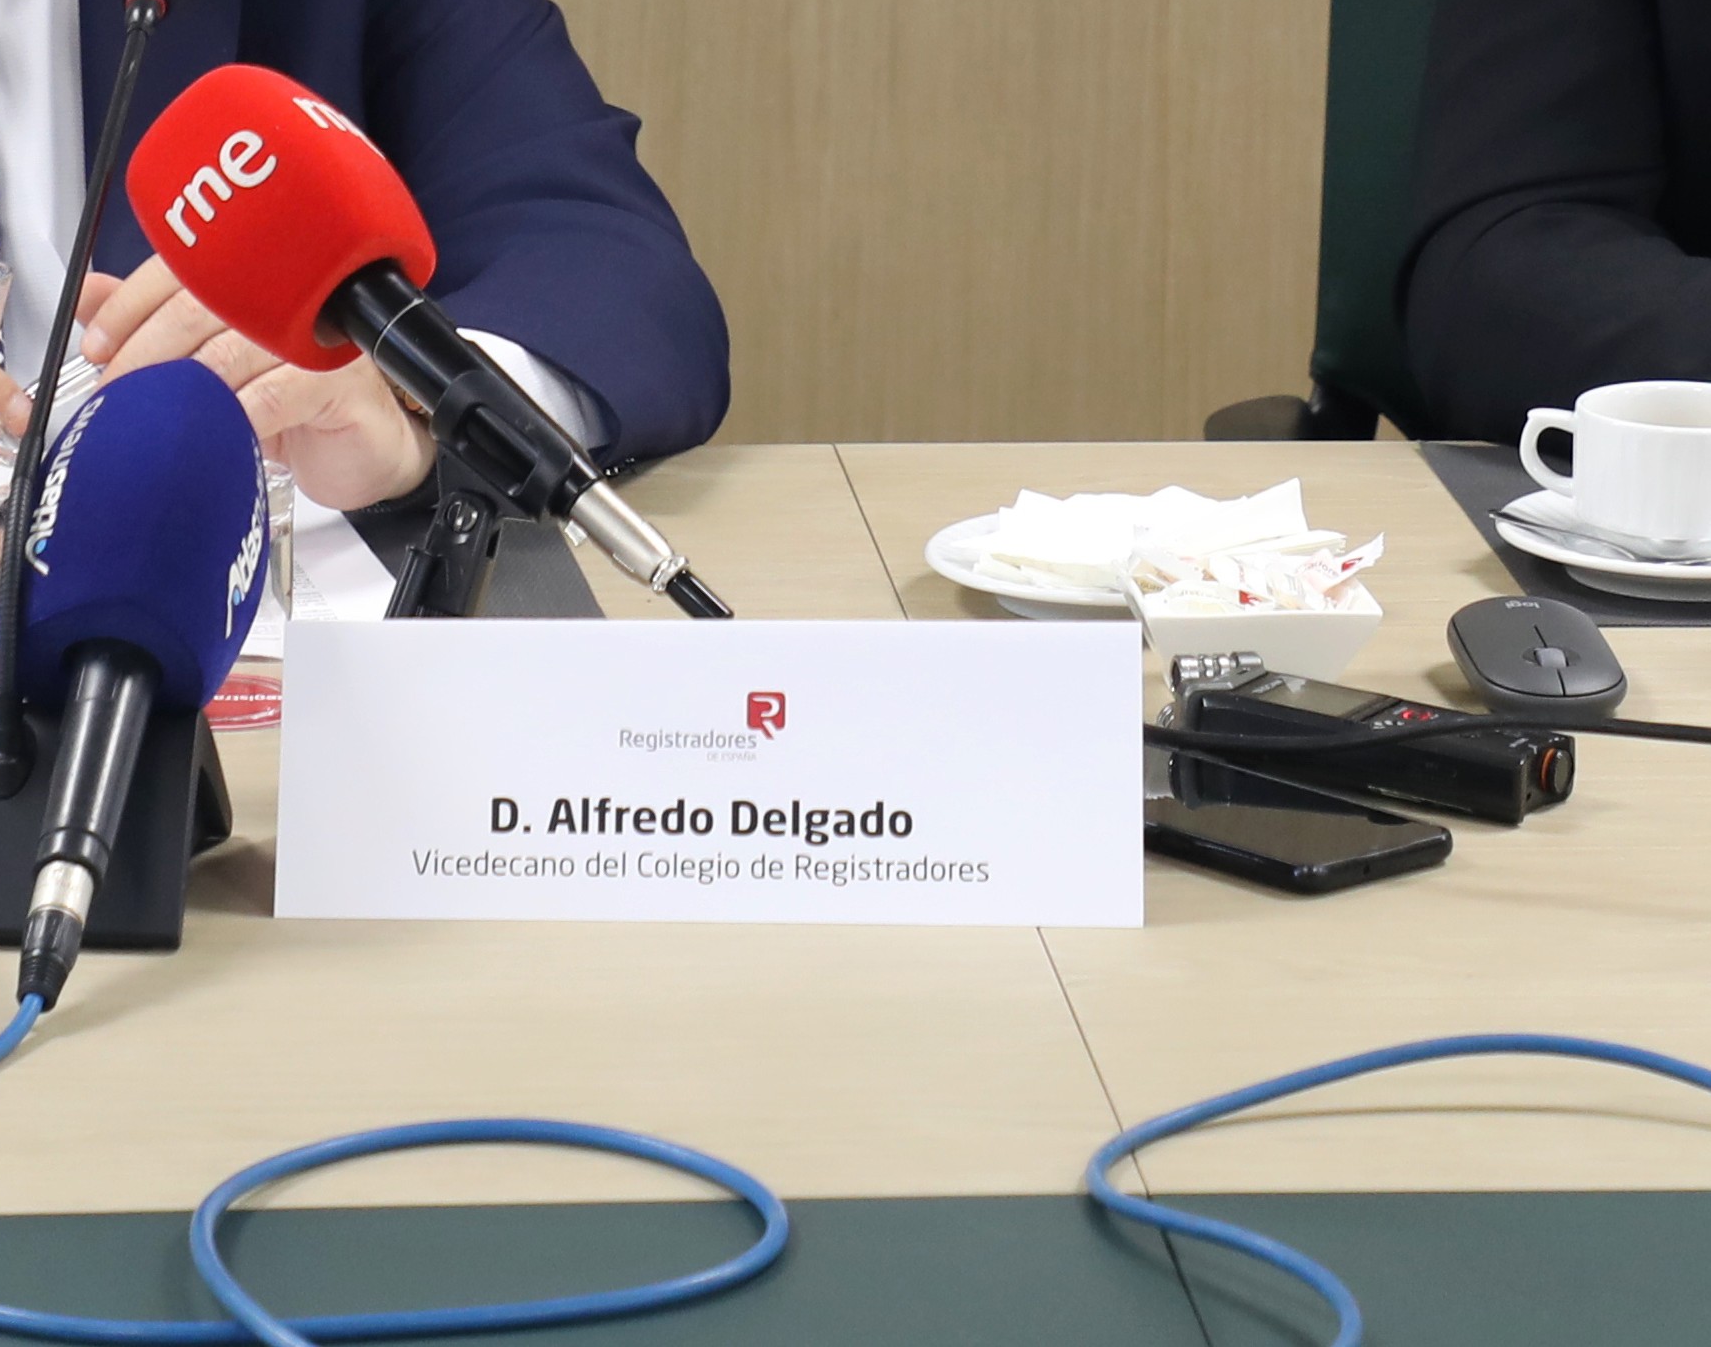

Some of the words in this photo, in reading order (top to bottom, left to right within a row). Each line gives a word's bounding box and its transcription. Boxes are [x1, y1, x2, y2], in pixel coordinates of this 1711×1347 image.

[165, 129, 277, 248] rne
[618, 729, 757, 751] Registradores
[491, 798, 532, 834] D.
[547, 798, 714, 835] Alfredo
[731, 800, 913, 846] Delgado
[412, 849, 575, 877] Vicedecano
[585, 852, 627, 877] del
[638, 851, 740, 885] Colegio
[751, 854, 784, 880] de
[795, 854, 990, 887] Registradores
